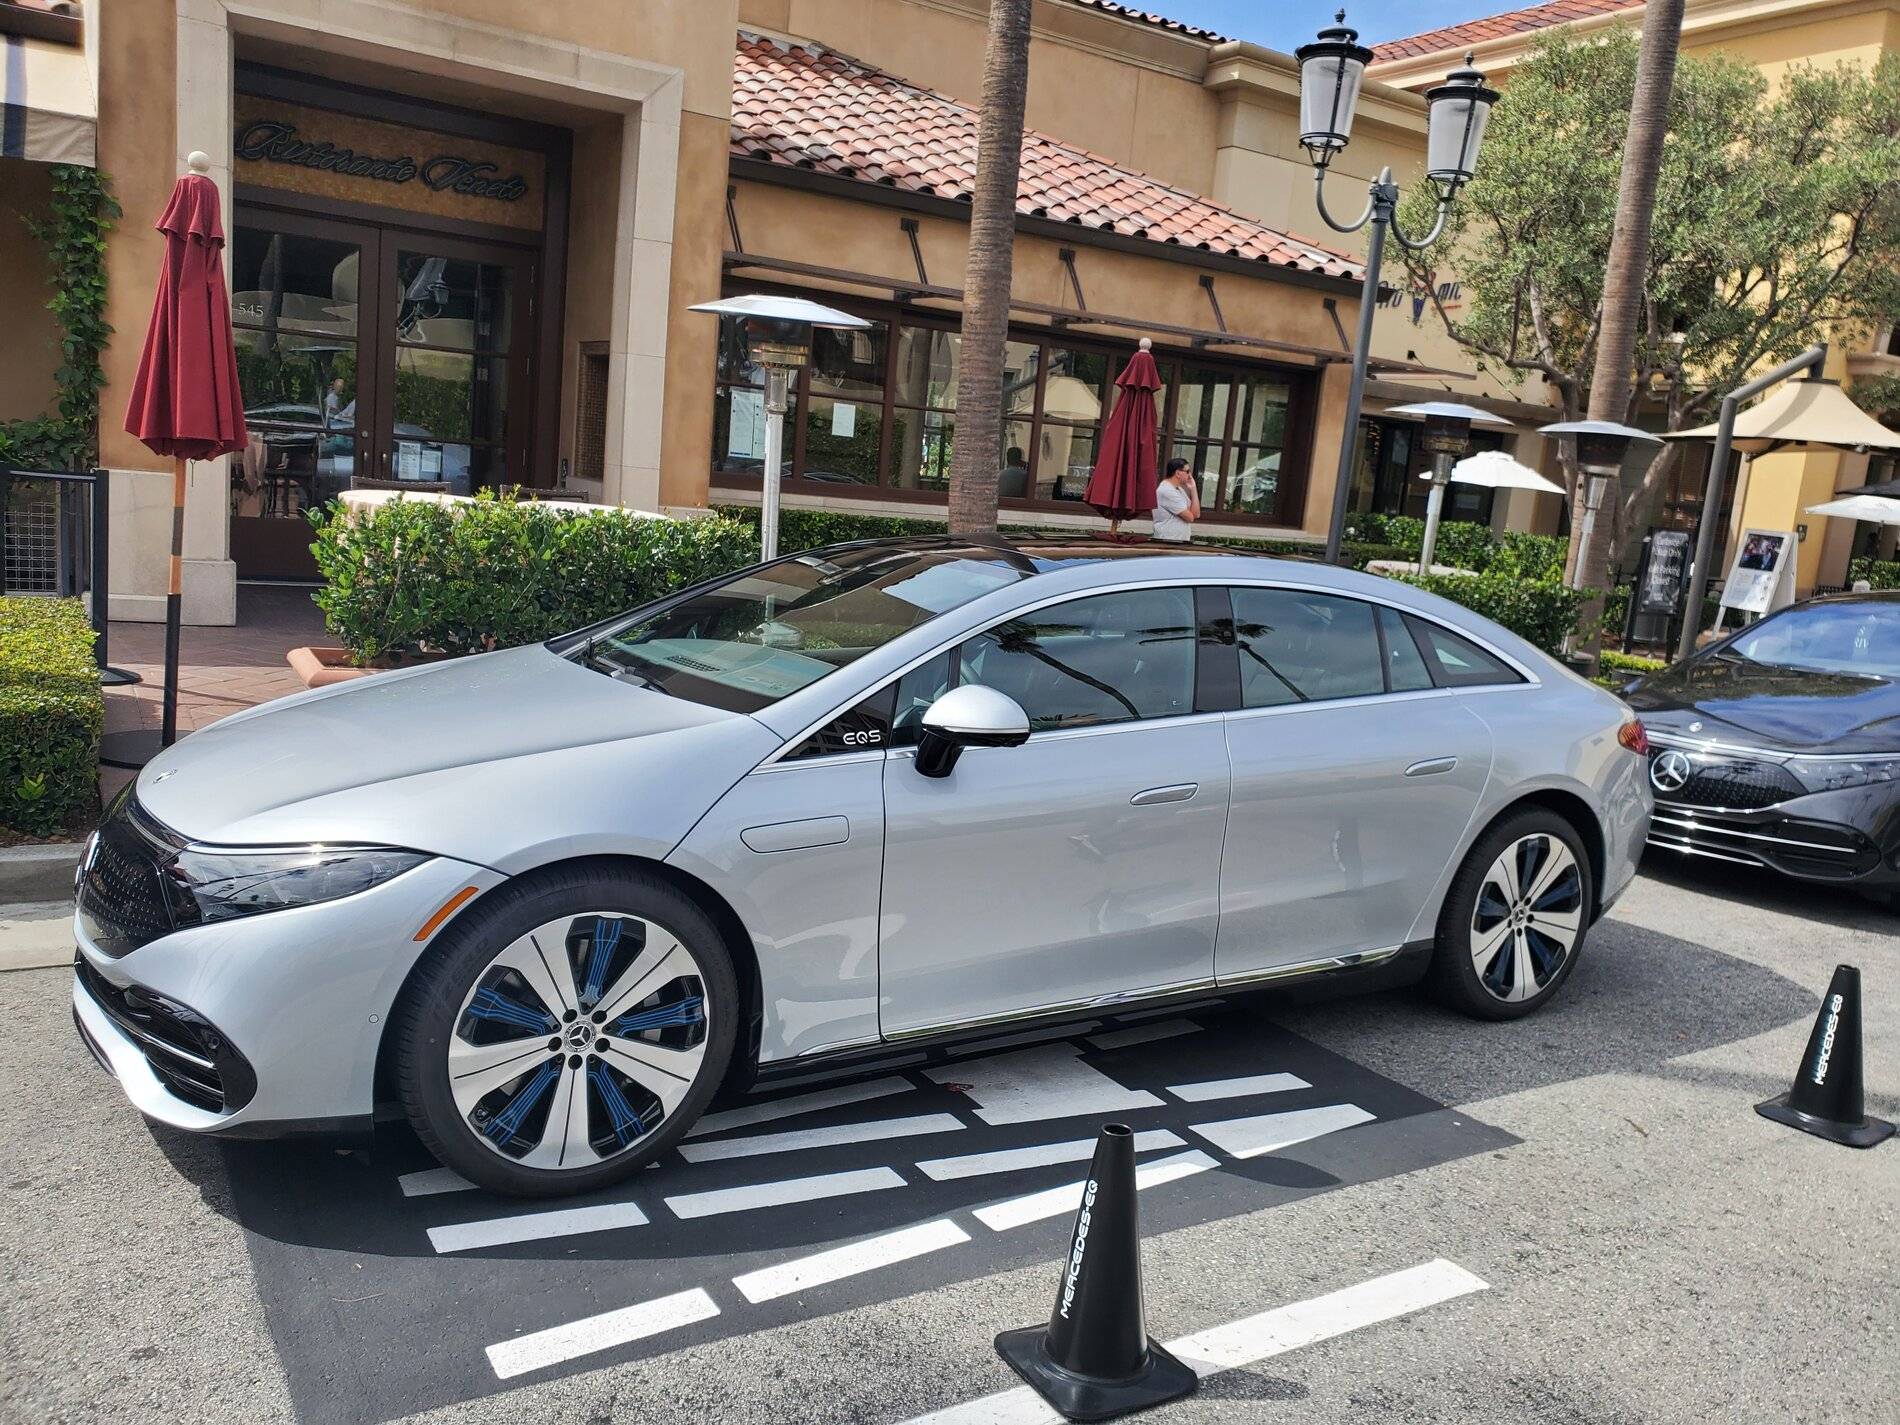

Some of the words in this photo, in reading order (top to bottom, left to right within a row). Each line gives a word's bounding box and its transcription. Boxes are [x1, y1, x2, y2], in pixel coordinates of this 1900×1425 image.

[239, 302, 264, 318] 545
[843, 729, 881, 745] EQS
[1060, 1179, 1099, 1319] MERCEDES-EQ
